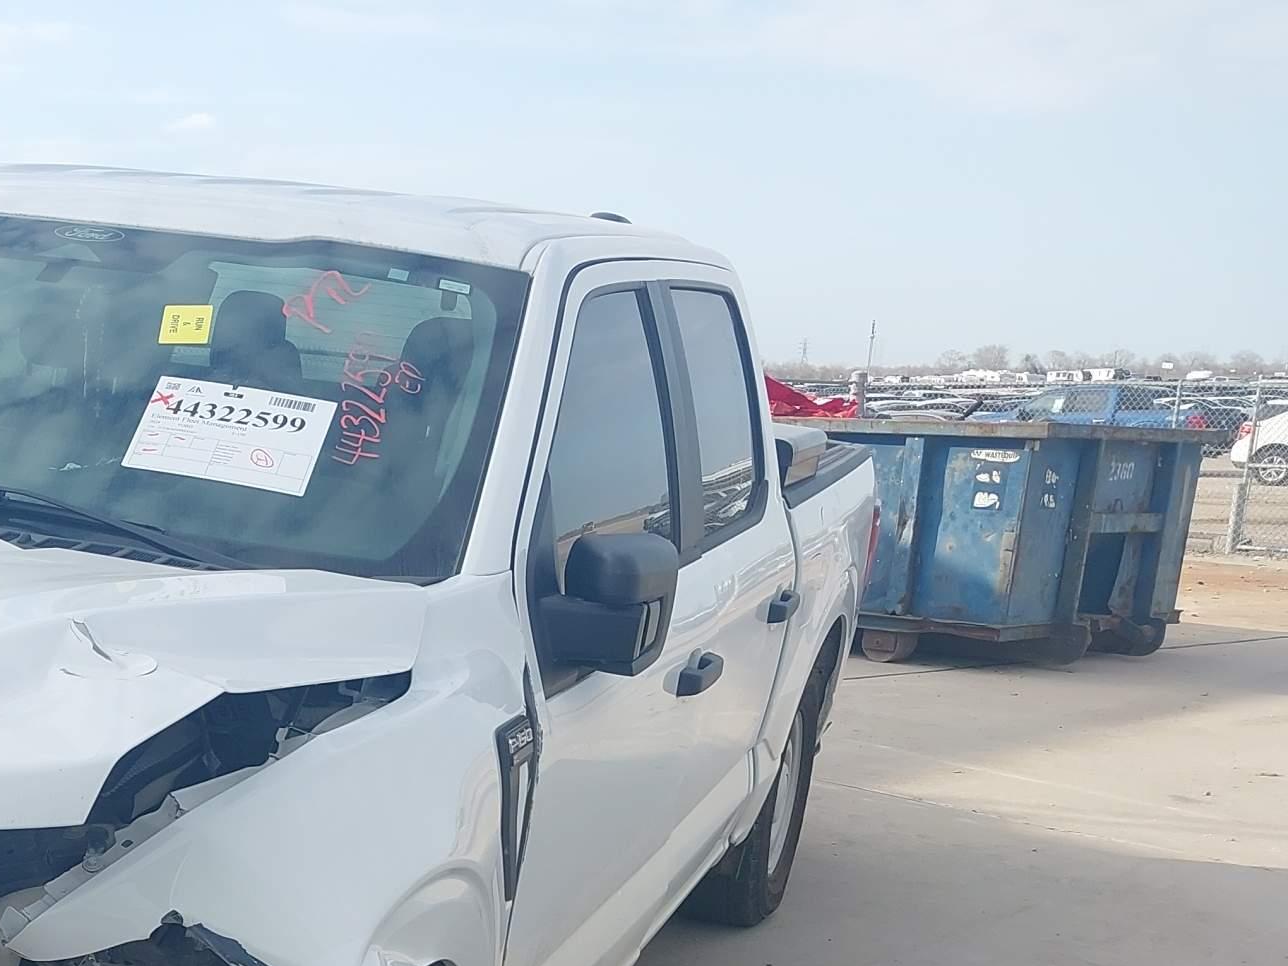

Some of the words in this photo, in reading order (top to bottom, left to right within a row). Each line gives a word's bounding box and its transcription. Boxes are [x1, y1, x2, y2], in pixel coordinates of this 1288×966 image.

[169, 314, 180, 334] DRIVE
[194, 317, 205, 331] RUN
[165, 397, 306, 434] 44322599
